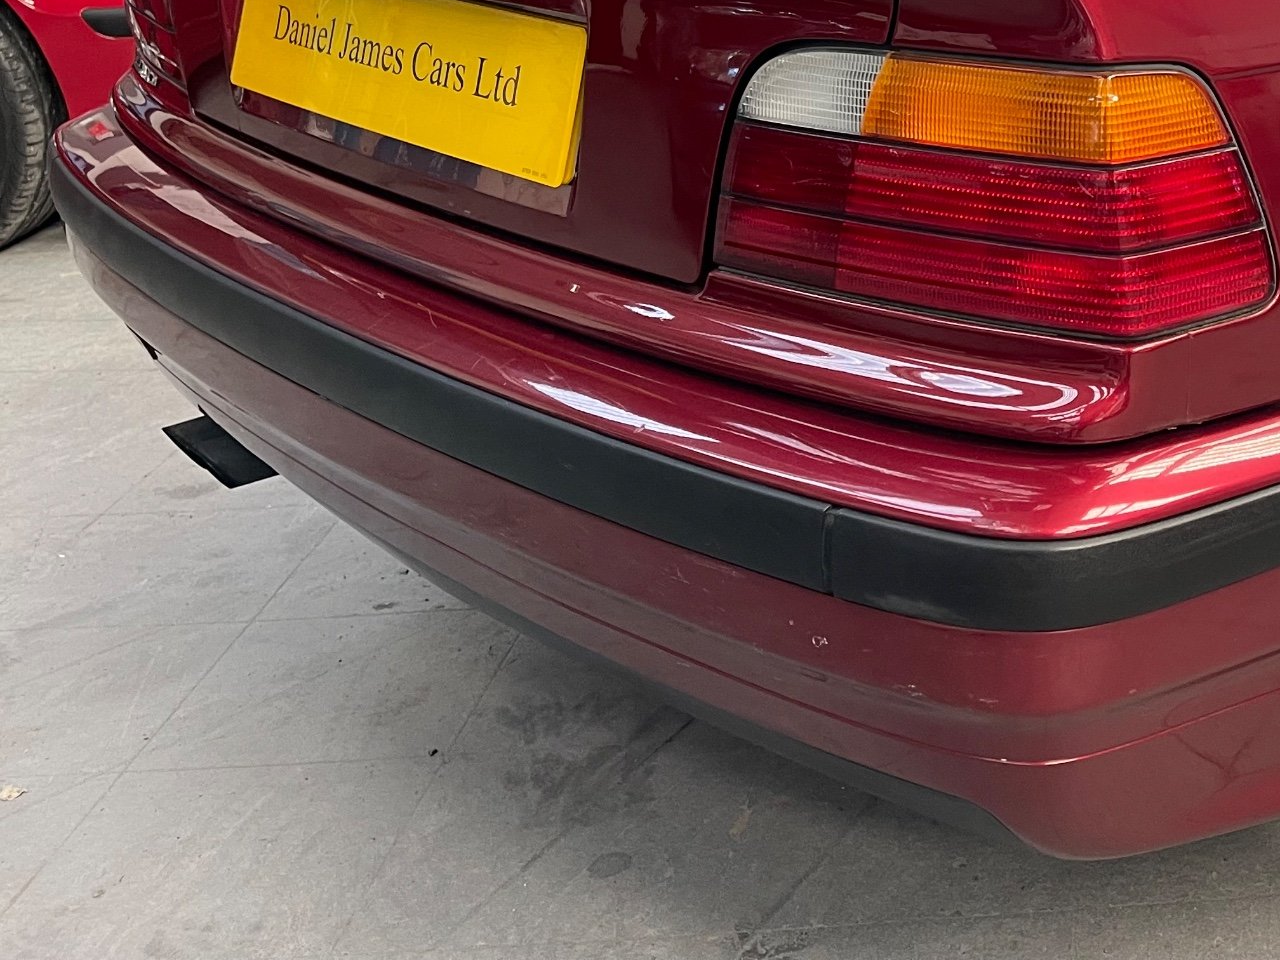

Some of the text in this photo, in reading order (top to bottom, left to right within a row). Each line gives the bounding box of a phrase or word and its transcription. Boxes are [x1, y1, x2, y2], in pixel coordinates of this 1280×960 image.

[272, 3, 523, 108] Daniel James Cars Ltd
